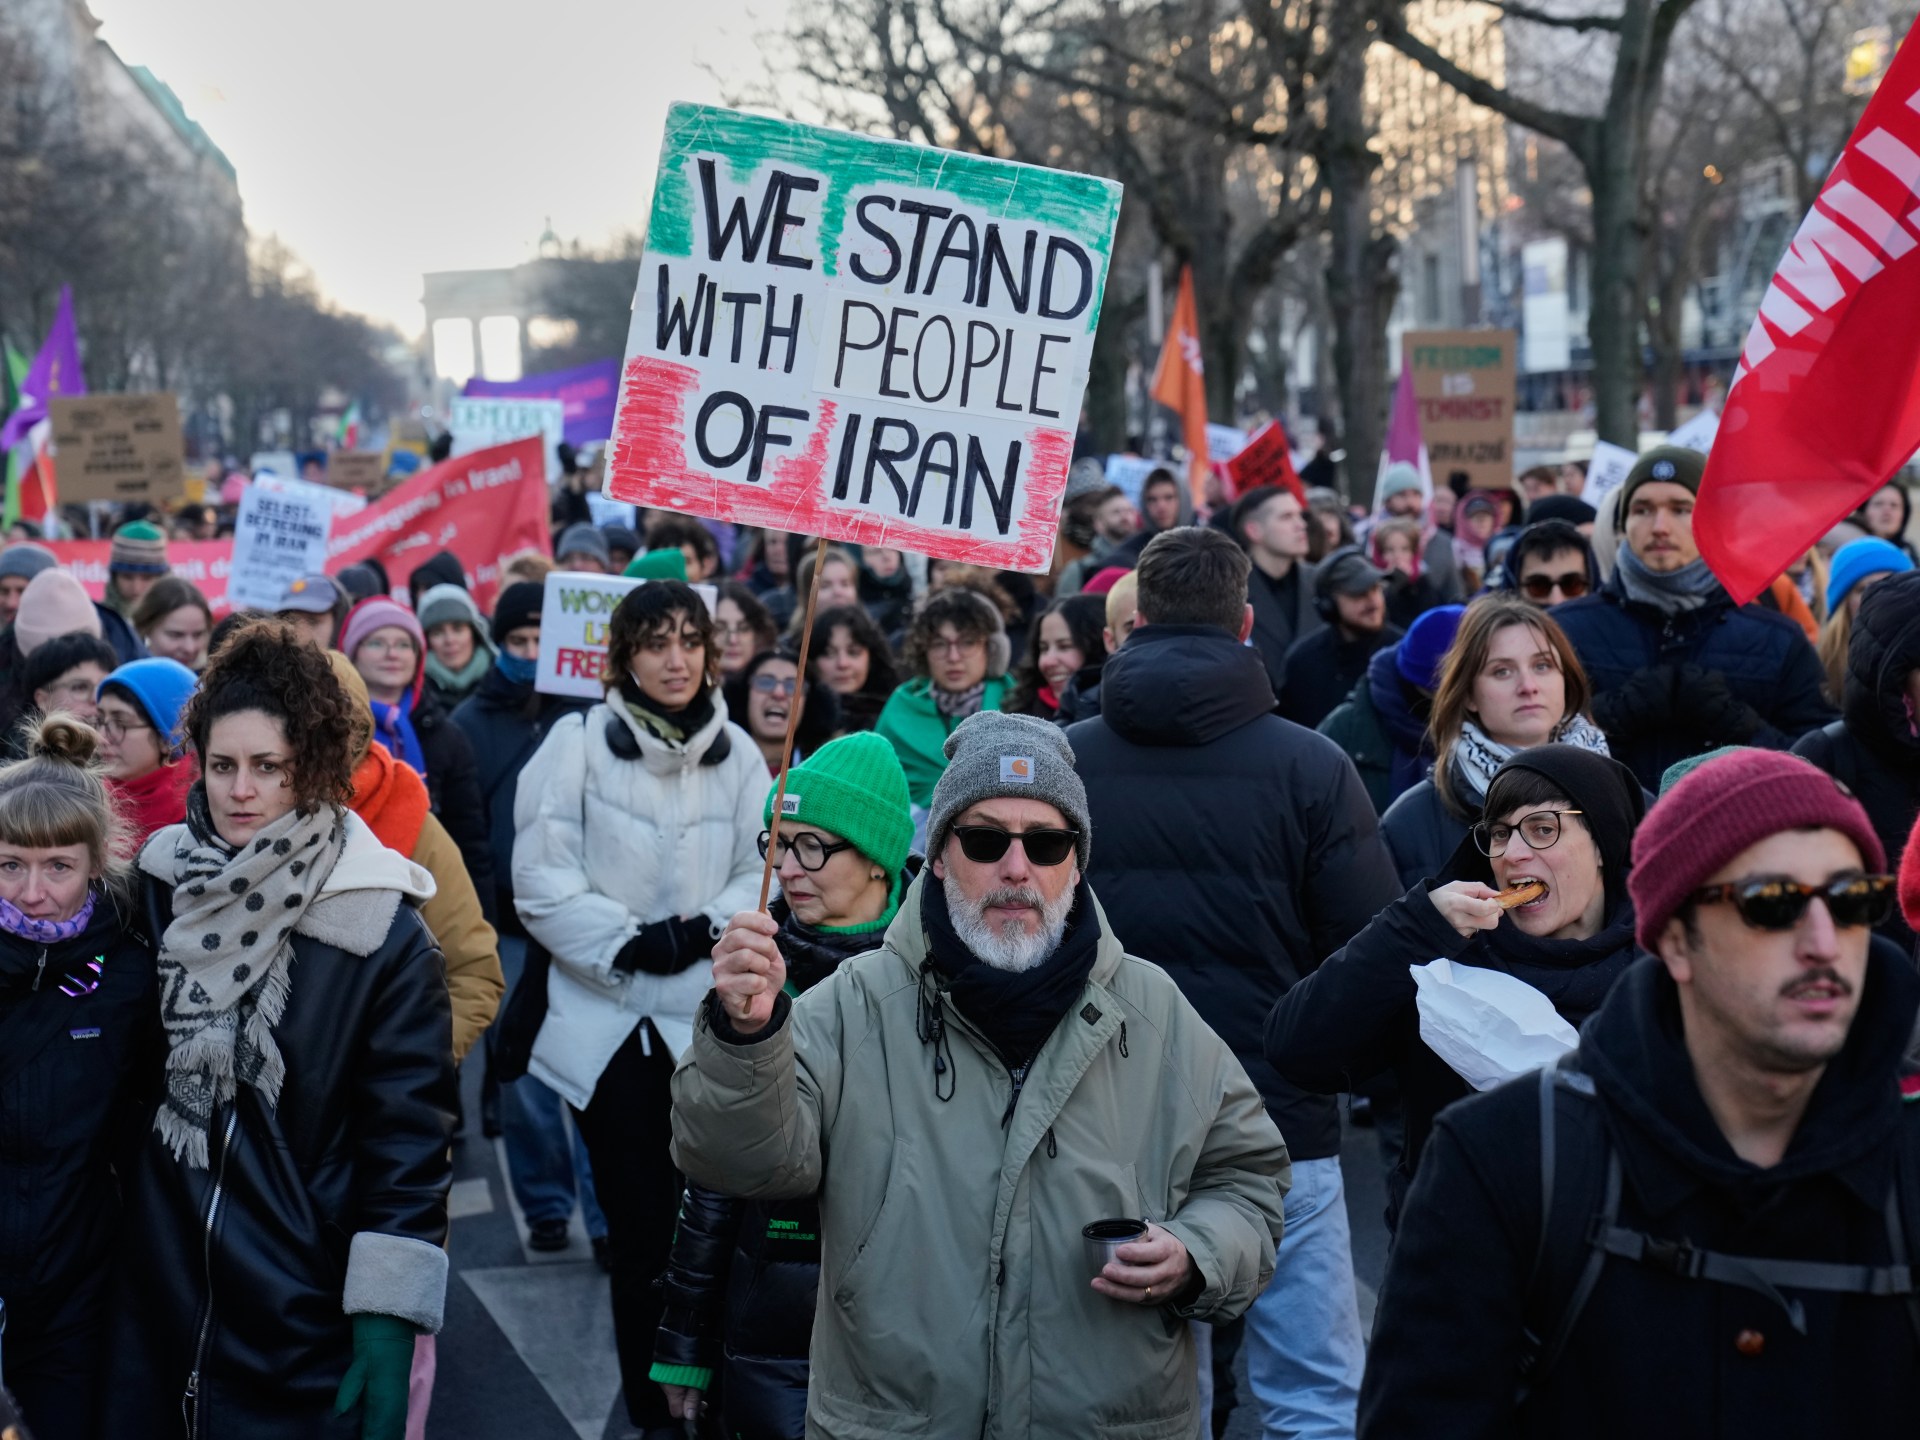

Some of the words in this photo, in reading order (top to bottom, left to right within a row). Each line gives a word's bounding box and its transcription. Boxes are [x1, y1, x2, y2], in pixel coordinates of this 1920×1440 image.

[697, 158, 819, 270] WE
[848, 194, 1094, 320] STAND
[656, 263, 803, 374] WITH
[833, 299, 1072, 418] PEOPLE
[1441, 372, 1475, 396] IS
[695, 390, 810, 482] OF
[832, 413, 1022, 535] IRAN
[276, 536, 308, 551] IRAN
